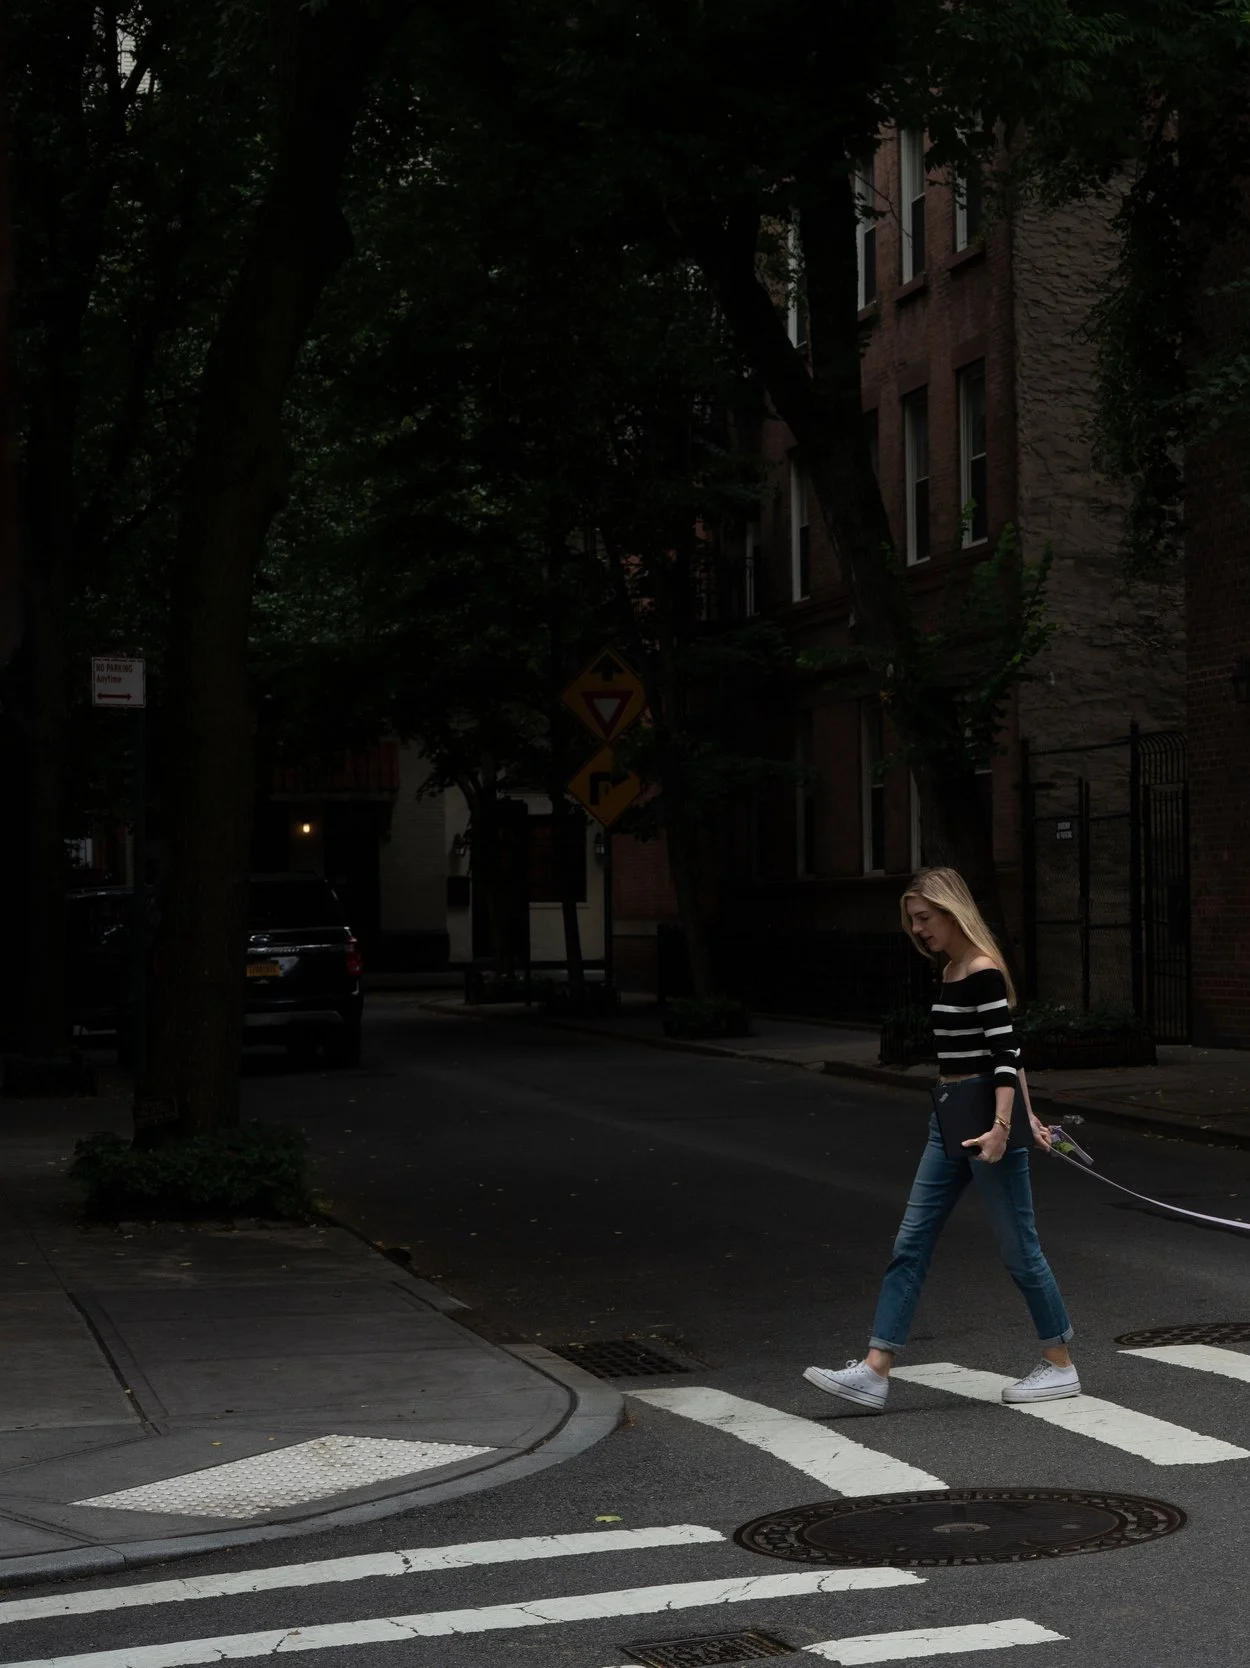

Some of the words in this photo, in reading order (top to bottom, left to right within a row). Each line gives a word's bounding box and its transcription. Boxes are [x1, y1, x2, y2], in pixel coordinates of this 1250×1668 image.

[96, 664, 105, 672] NO
[106, 664, 133, 673] PARKING
[96, 674, 122, 684] Anytime
